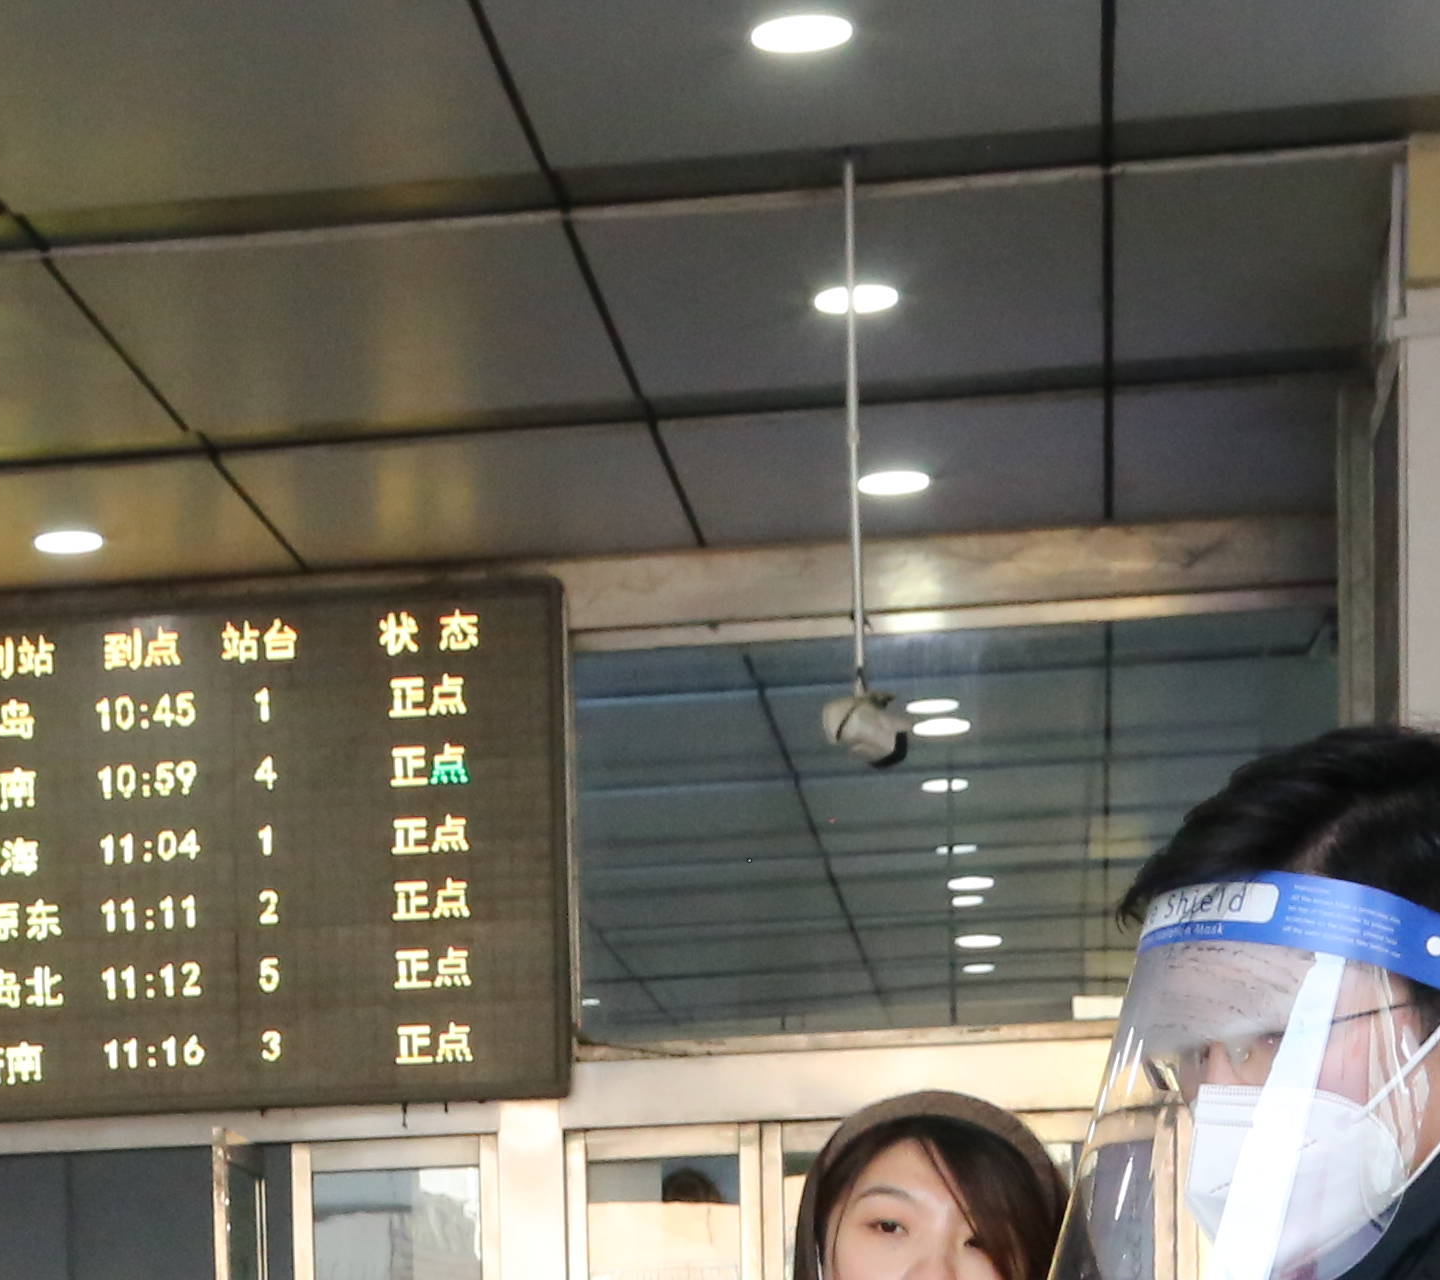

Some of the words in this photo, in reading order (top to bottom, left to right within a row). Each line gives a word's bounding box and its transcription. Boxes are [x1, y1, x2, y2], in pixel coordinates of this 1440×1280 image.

[103, 624, 182, 671] 到点
[221, 618, 297, 664] 站台
[95, 690, 196, 732] 10:45
[254, 686, 270, 723] 1
[388, 672, 467, 718] 正点
[97, 759, 197, 800] 10:59
[254, 755, 278, 790] 4
[390, 742, 469, 787] 正点
[99, 828, 201, 865] 11:04
[257, 824, 273, 856] 1
[391, 813, 470, 855] 正点
[100, 894, 196, 933] 11:11
[258, 889, 279, 925] 2
[392, 876, 471, 921] 正点
[1165, 882, 1247, 921] Shield
[101, 961, 202, 1001] 11:12
[258, 957, 280, 992] 5
[393, 945, 472, 990] 正点
[103, 1034, 205, 1070] 11:16
[261, 1030, 281, 1062] 3
[395, 1021, 473, 1065] 正点
